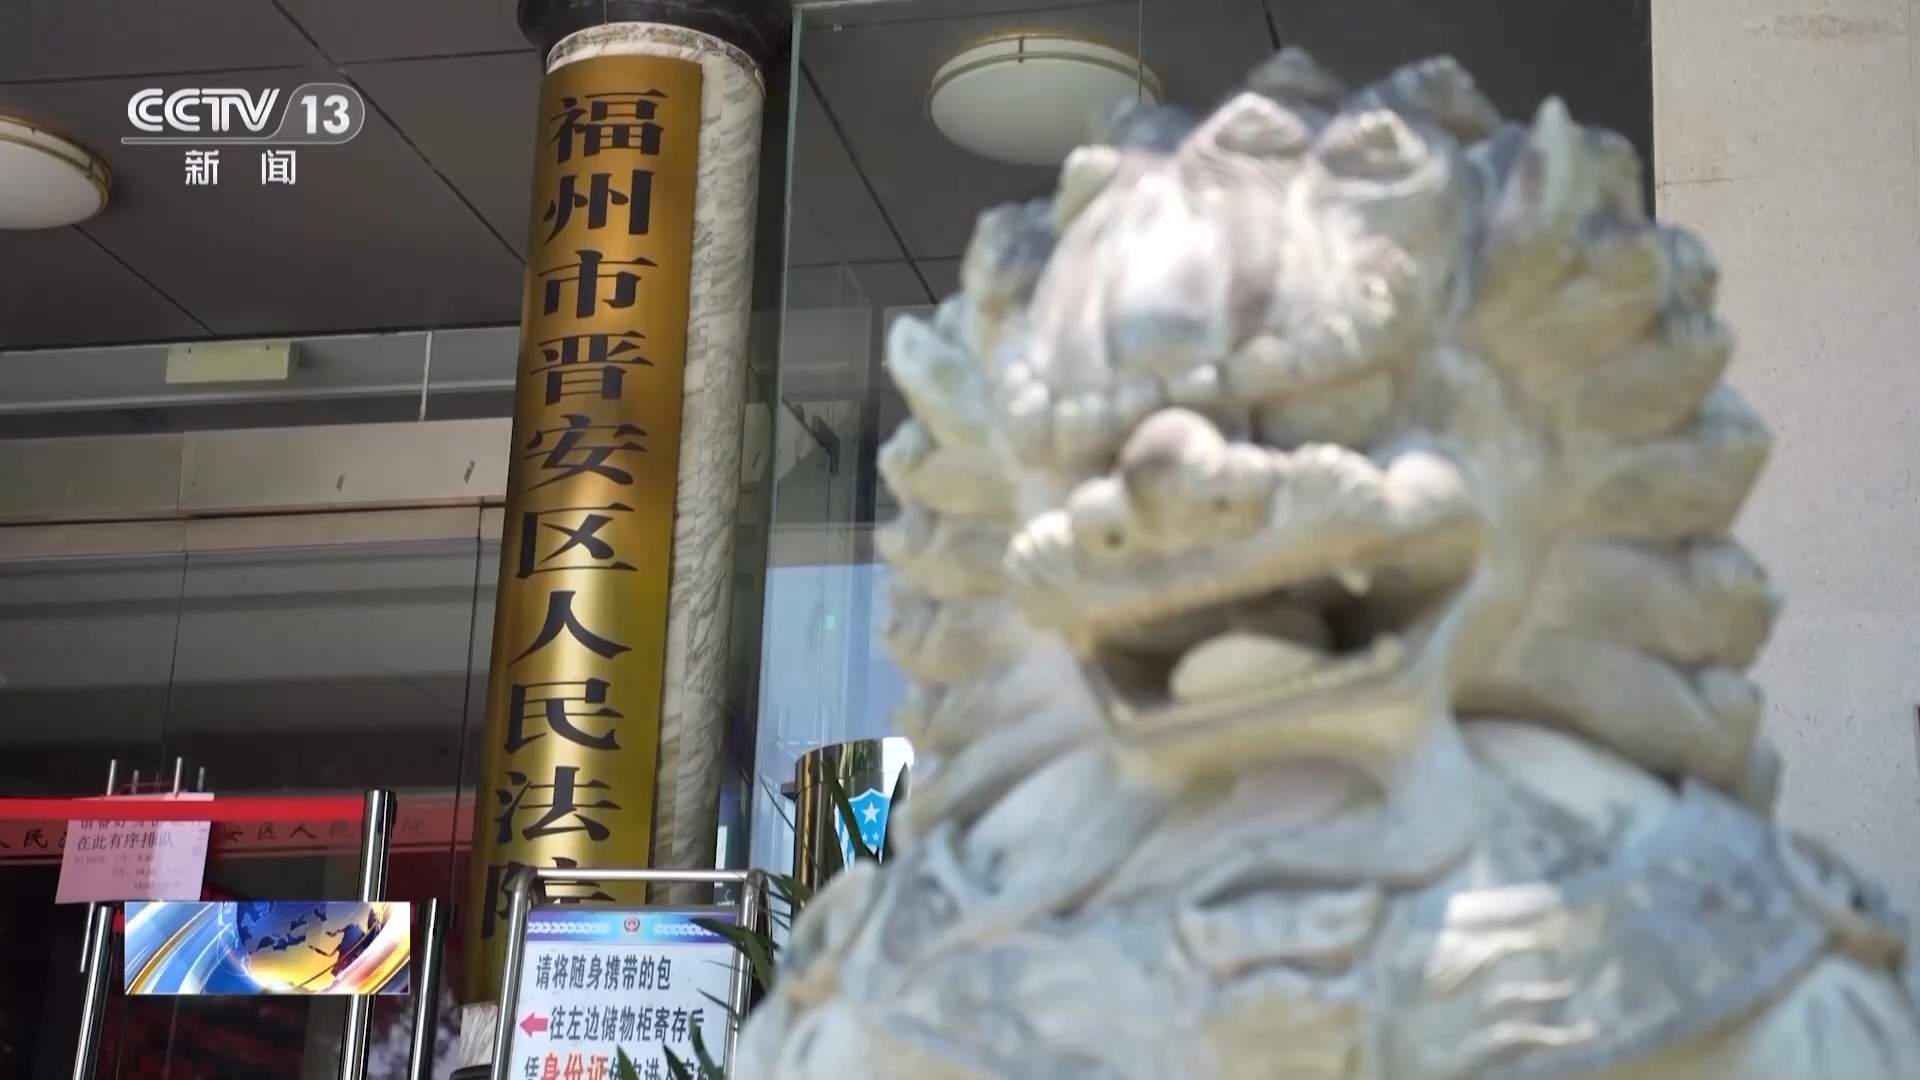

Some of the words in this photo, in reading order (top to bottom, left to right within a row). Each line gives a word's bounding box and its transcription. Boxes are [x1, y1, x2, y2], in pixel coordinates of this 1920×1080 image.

[77, 830, 174, 851] 在此有序排队
[535, 954, 672, 991] 请将随身携带的包
